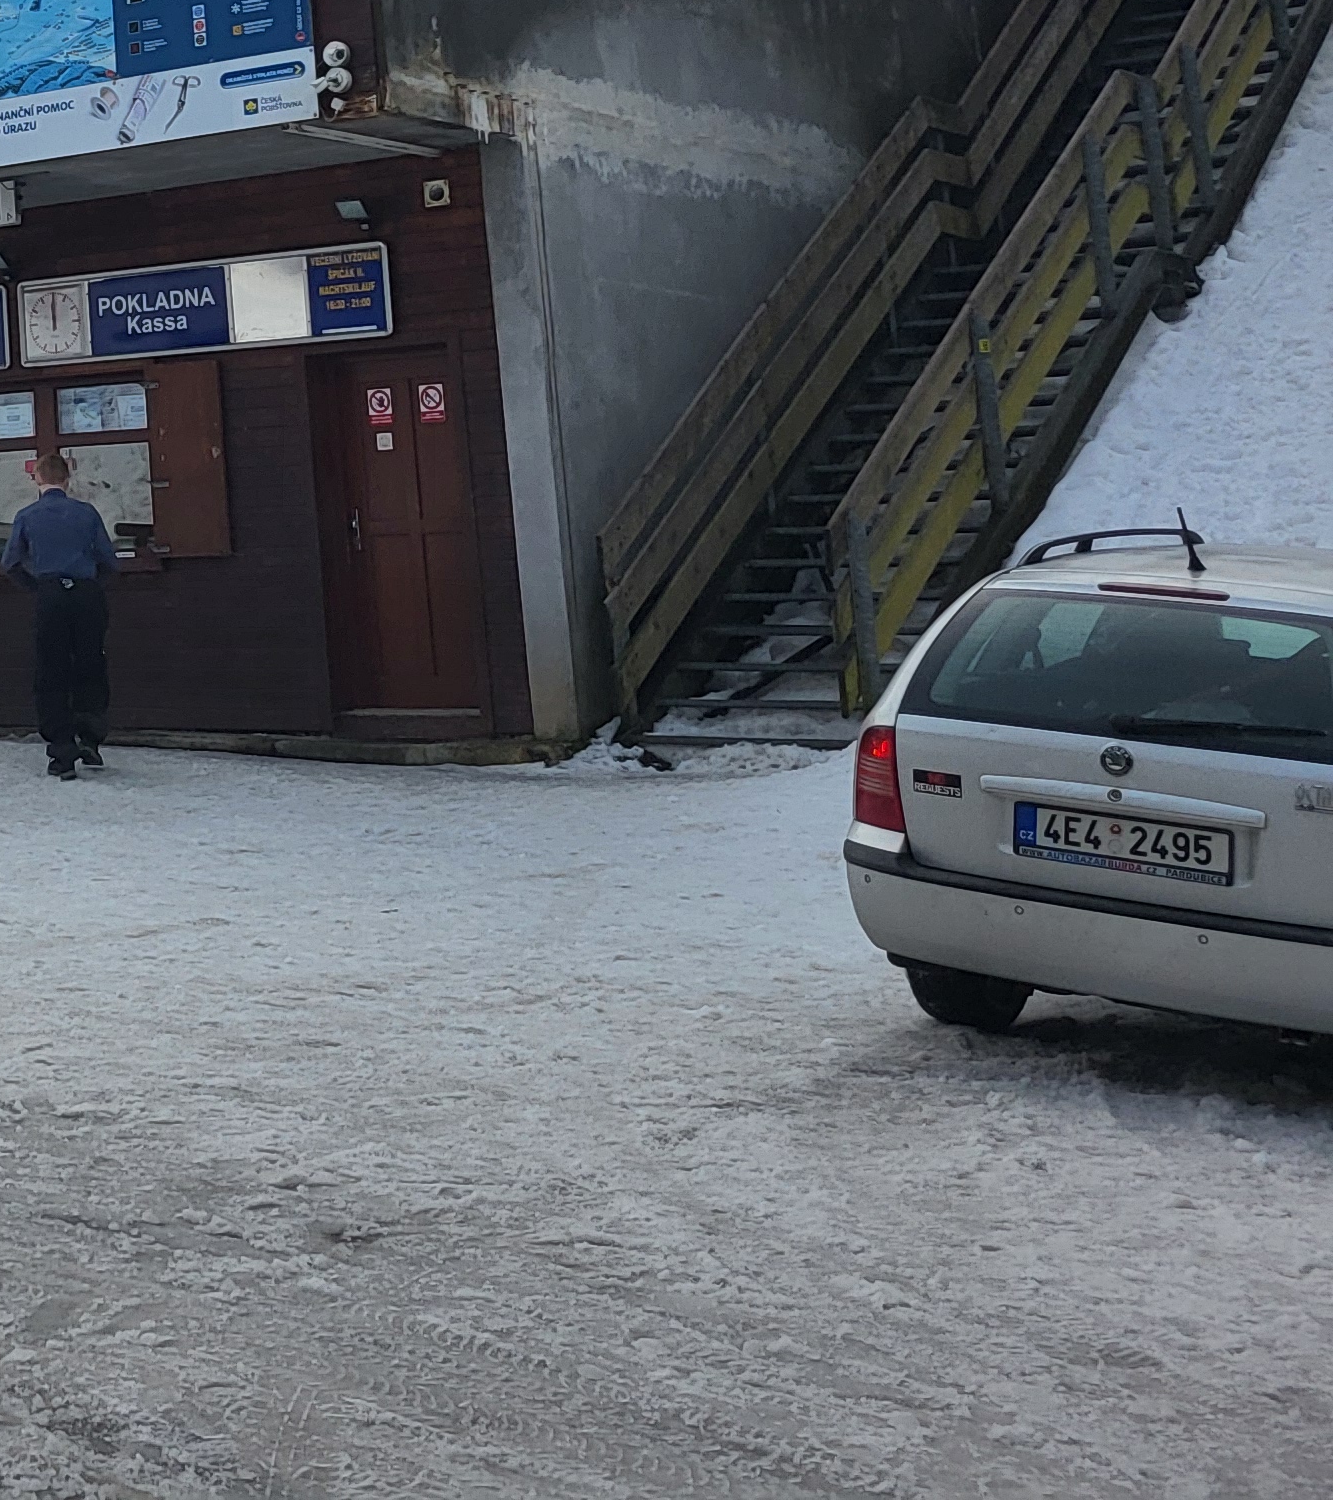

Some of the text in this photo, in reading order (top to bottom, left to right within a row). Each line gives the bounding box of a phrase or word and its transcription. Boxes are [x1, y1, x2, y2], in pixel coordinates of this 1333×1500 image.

[35, 99, 75, 115] POMOC
[260, 94, 283, 104] ČESKÁ
[2, 118, 38, 136] ÚRAZU
[97, 286, 216, 317] POKLADNA
[126, 312, 188, 336] Kassa
[914, 782, 961, 798] REQUESTS
[1019, 813, 1213, 866] CZ 4E4 2495
[1165, 868, 1224, 885] PARDUBICE
